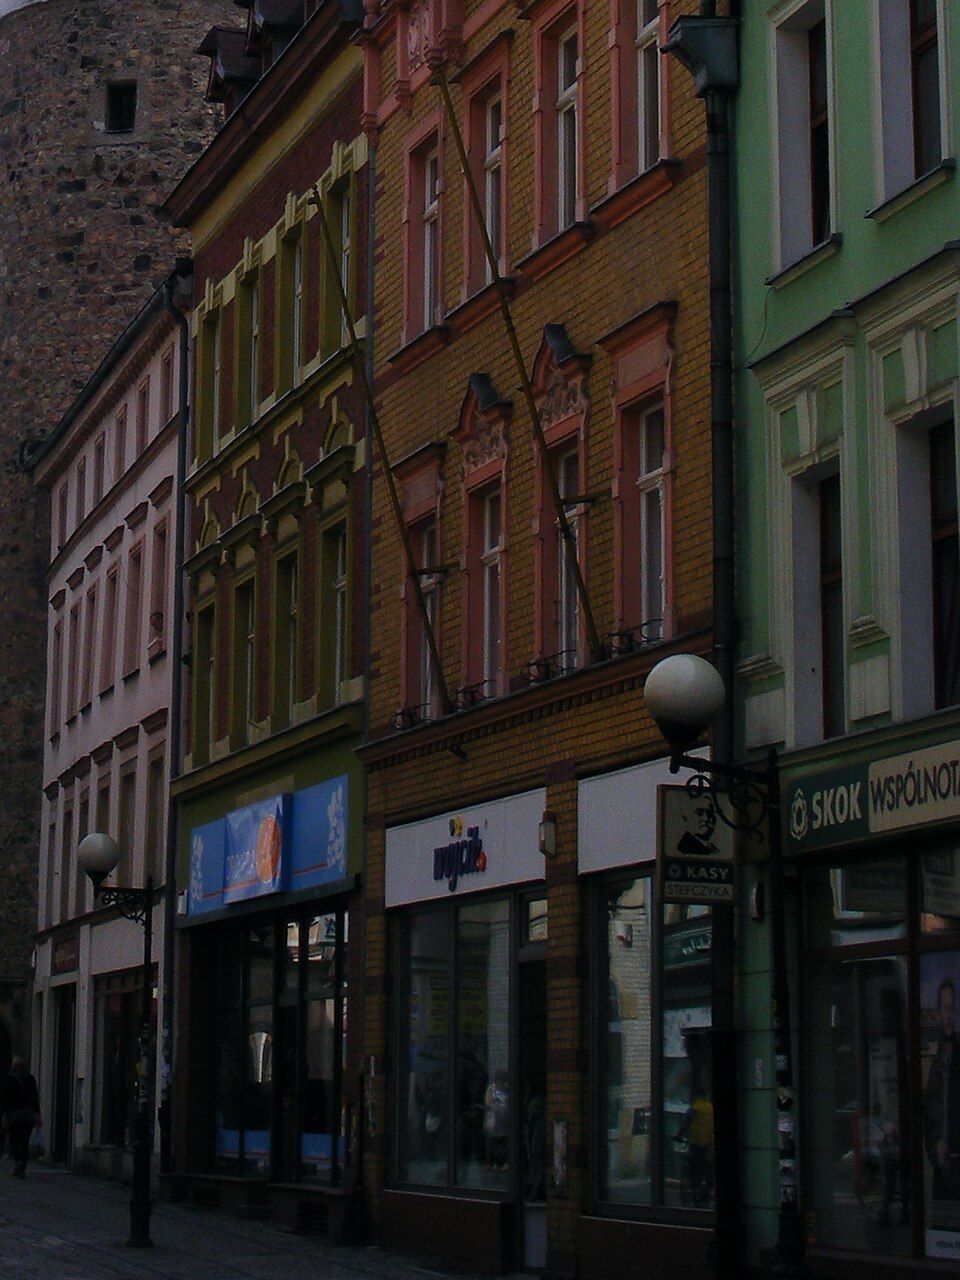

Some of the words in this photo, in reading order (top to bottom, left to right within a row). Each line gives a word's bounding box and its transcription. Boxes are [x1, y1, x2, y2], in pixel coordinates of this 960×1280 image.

[811, 781, 863, 830] SKOK
[870, 760, 960, 813] WSPÓLNOT
[686, 865, 729, 880] KASY
